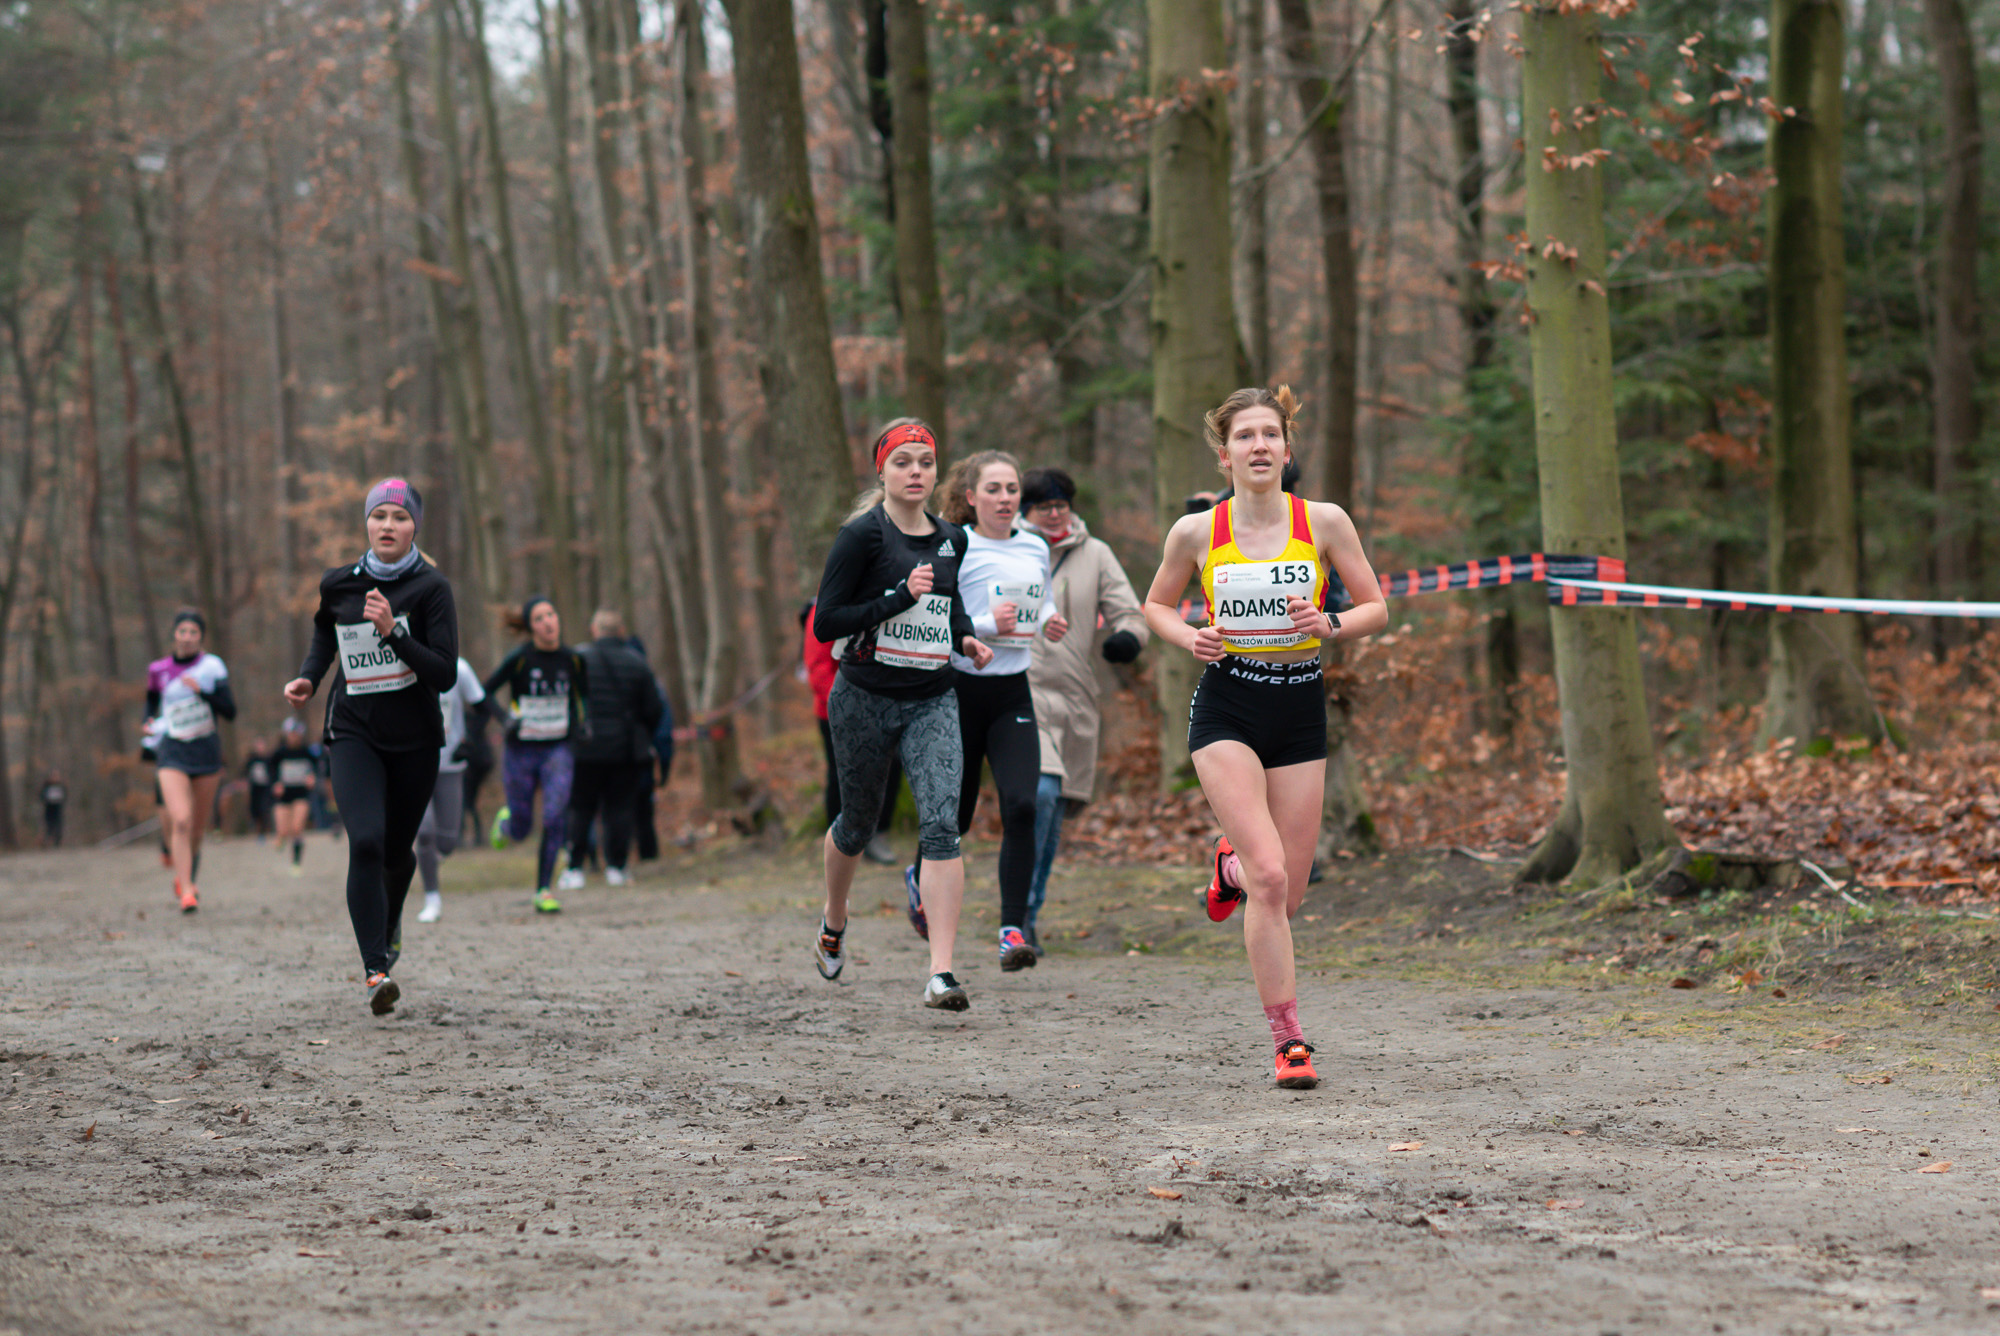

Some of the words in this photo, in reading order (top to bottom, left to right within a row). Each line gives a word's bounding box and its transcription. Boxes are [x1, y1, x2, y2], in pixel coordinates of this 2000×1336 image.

[1270, 565, 1310, 584] 153
[926, 599, 949, 616] 464
[1219, 596, 1306, 617] ADAMS
[883, 622, 949, 643] LUBIŃSKA
[1224, 637, 1263, 646] OMASZÓW
[1265, 637, 1296, 645] LUBELSKI
[348, 649, 399, 669] DZIUB
